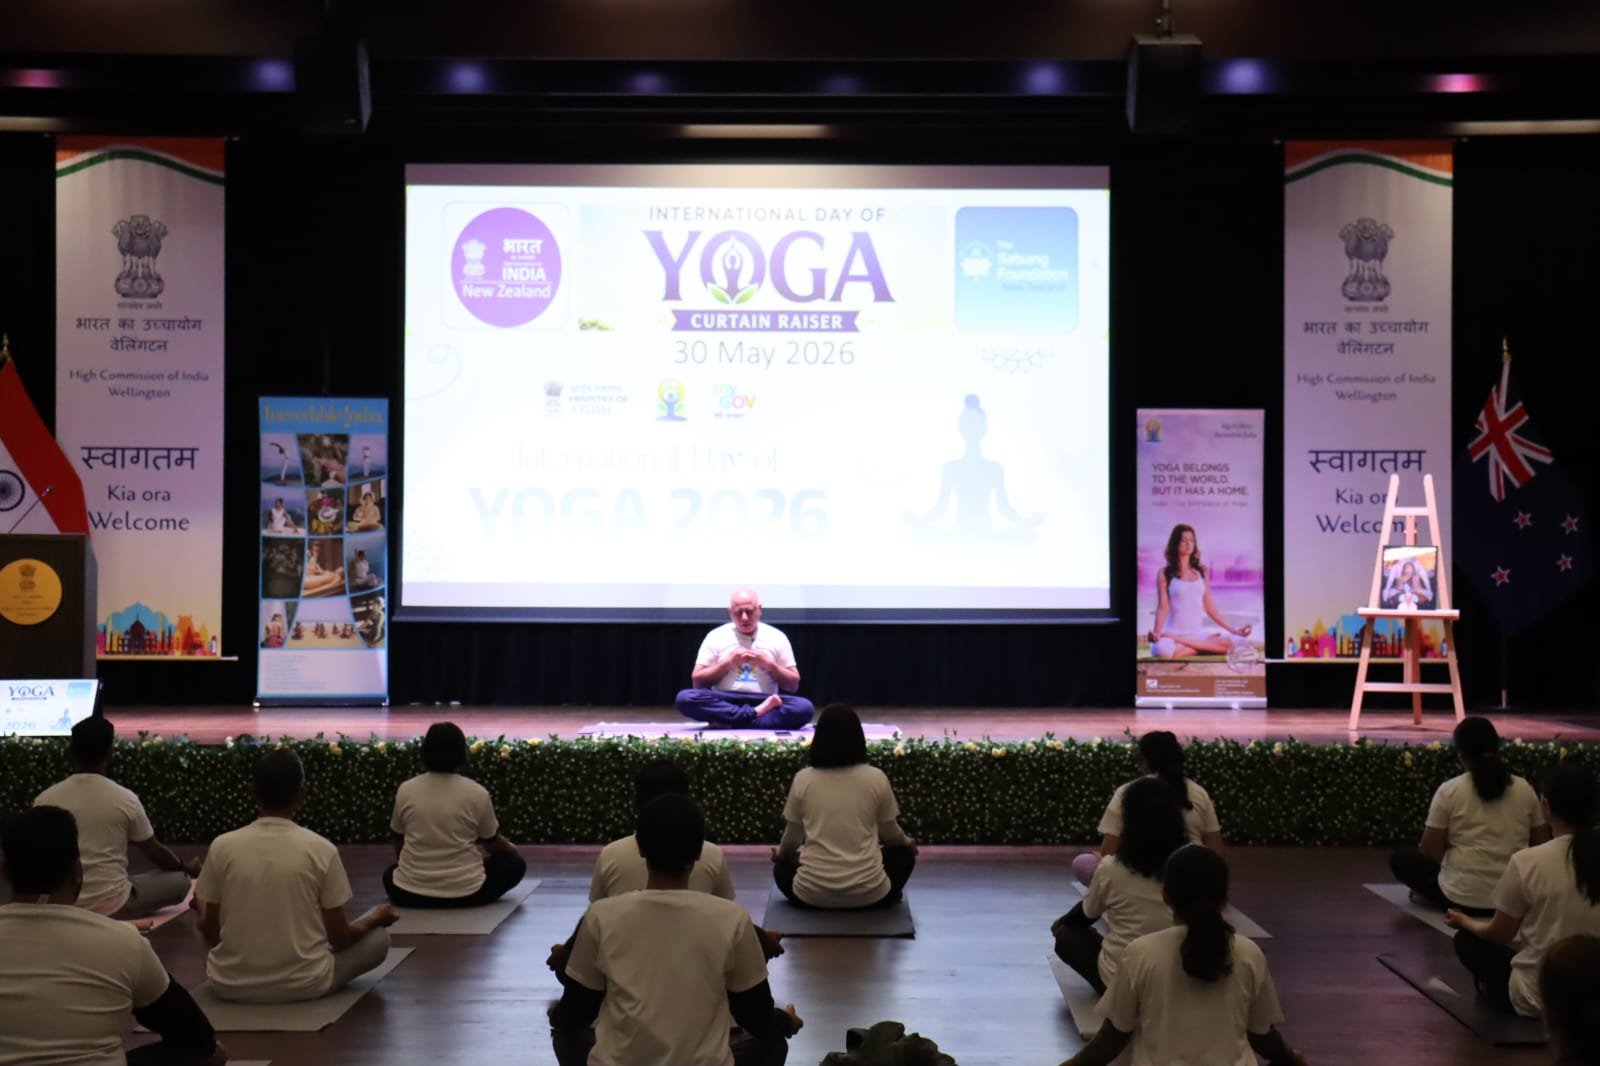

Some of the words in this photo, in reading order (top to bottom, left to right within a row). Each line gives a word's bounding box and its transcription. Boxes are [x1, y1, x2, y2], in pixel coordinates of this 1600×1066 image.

[649, 206, 807, 222] INTERNATIONAL
[815, 207, 853, 222] DAY
[860, 208, 885, 222] OF
[502, 238, 544, 255] भारत
[502, 266, 547, 281] INDIA
[641, 229, 897, 304] YOGA
[461, 284, 494, 298] New
[496, 284, 551, 298] Zealand
[75, 317, 111, 331] भारत
[117, 317, 135, 331] का
[143, 315, 203, 331] उच्चायोग
[690, 313, 771, 329] CURTAIN
[778, 314, 843, 330] RAISER
[1303, 321, 1338, 335] भारत
[1344, 321, 1362, 334] का
[674, 340, 708, 364] 30
[718, 341, 776, 370] May
[786, 341, 855, 365] 2026
[69, 370, 97, 382] High
[99, 370, 165, 381] Commission
[167, 371, 180, 381] of
[181, 371, 210, 381] India
[1296, 373, 1324, 387] High
[1326, 373, 1391, 384] Commission
[1393, 373, 1407, 384] of
[1408, 373, 1437, 384] India
[108, 386, 171, 400] Wellington
[1335, 390, 1398, 403] Wellington
[80, 446, 200, 471] स्वागतम
[1308, 449, 1427, 474] स्वागतम
[1152, 463, 1180, 472] YOGA
[1182, 463, 1230, 472] BELONGS
[1152, 474, 1166, 483] TO
[1168, 474, 1186, 483] THE
[107, 484, 136, 501] Kia
[141, 490, 171, 502] ora
[1152, 486, 1171, 495] BUT
[1173, 486, 1182, 495] IT
[1185, 486, 1205, 495] HAS
[1207, 486, 1215, 495] A
[1335, 487, 1364, 505] Kia
[1369, 493, 1399, 505] or
[87, 510, 190, 531] Welcome
[468, 486, 650, 540] YOGA
[669, 486, 831, 542] 2026
[1315, 513, 1418, 534] Welcom
[8, 685, 55, 697] YOGA
